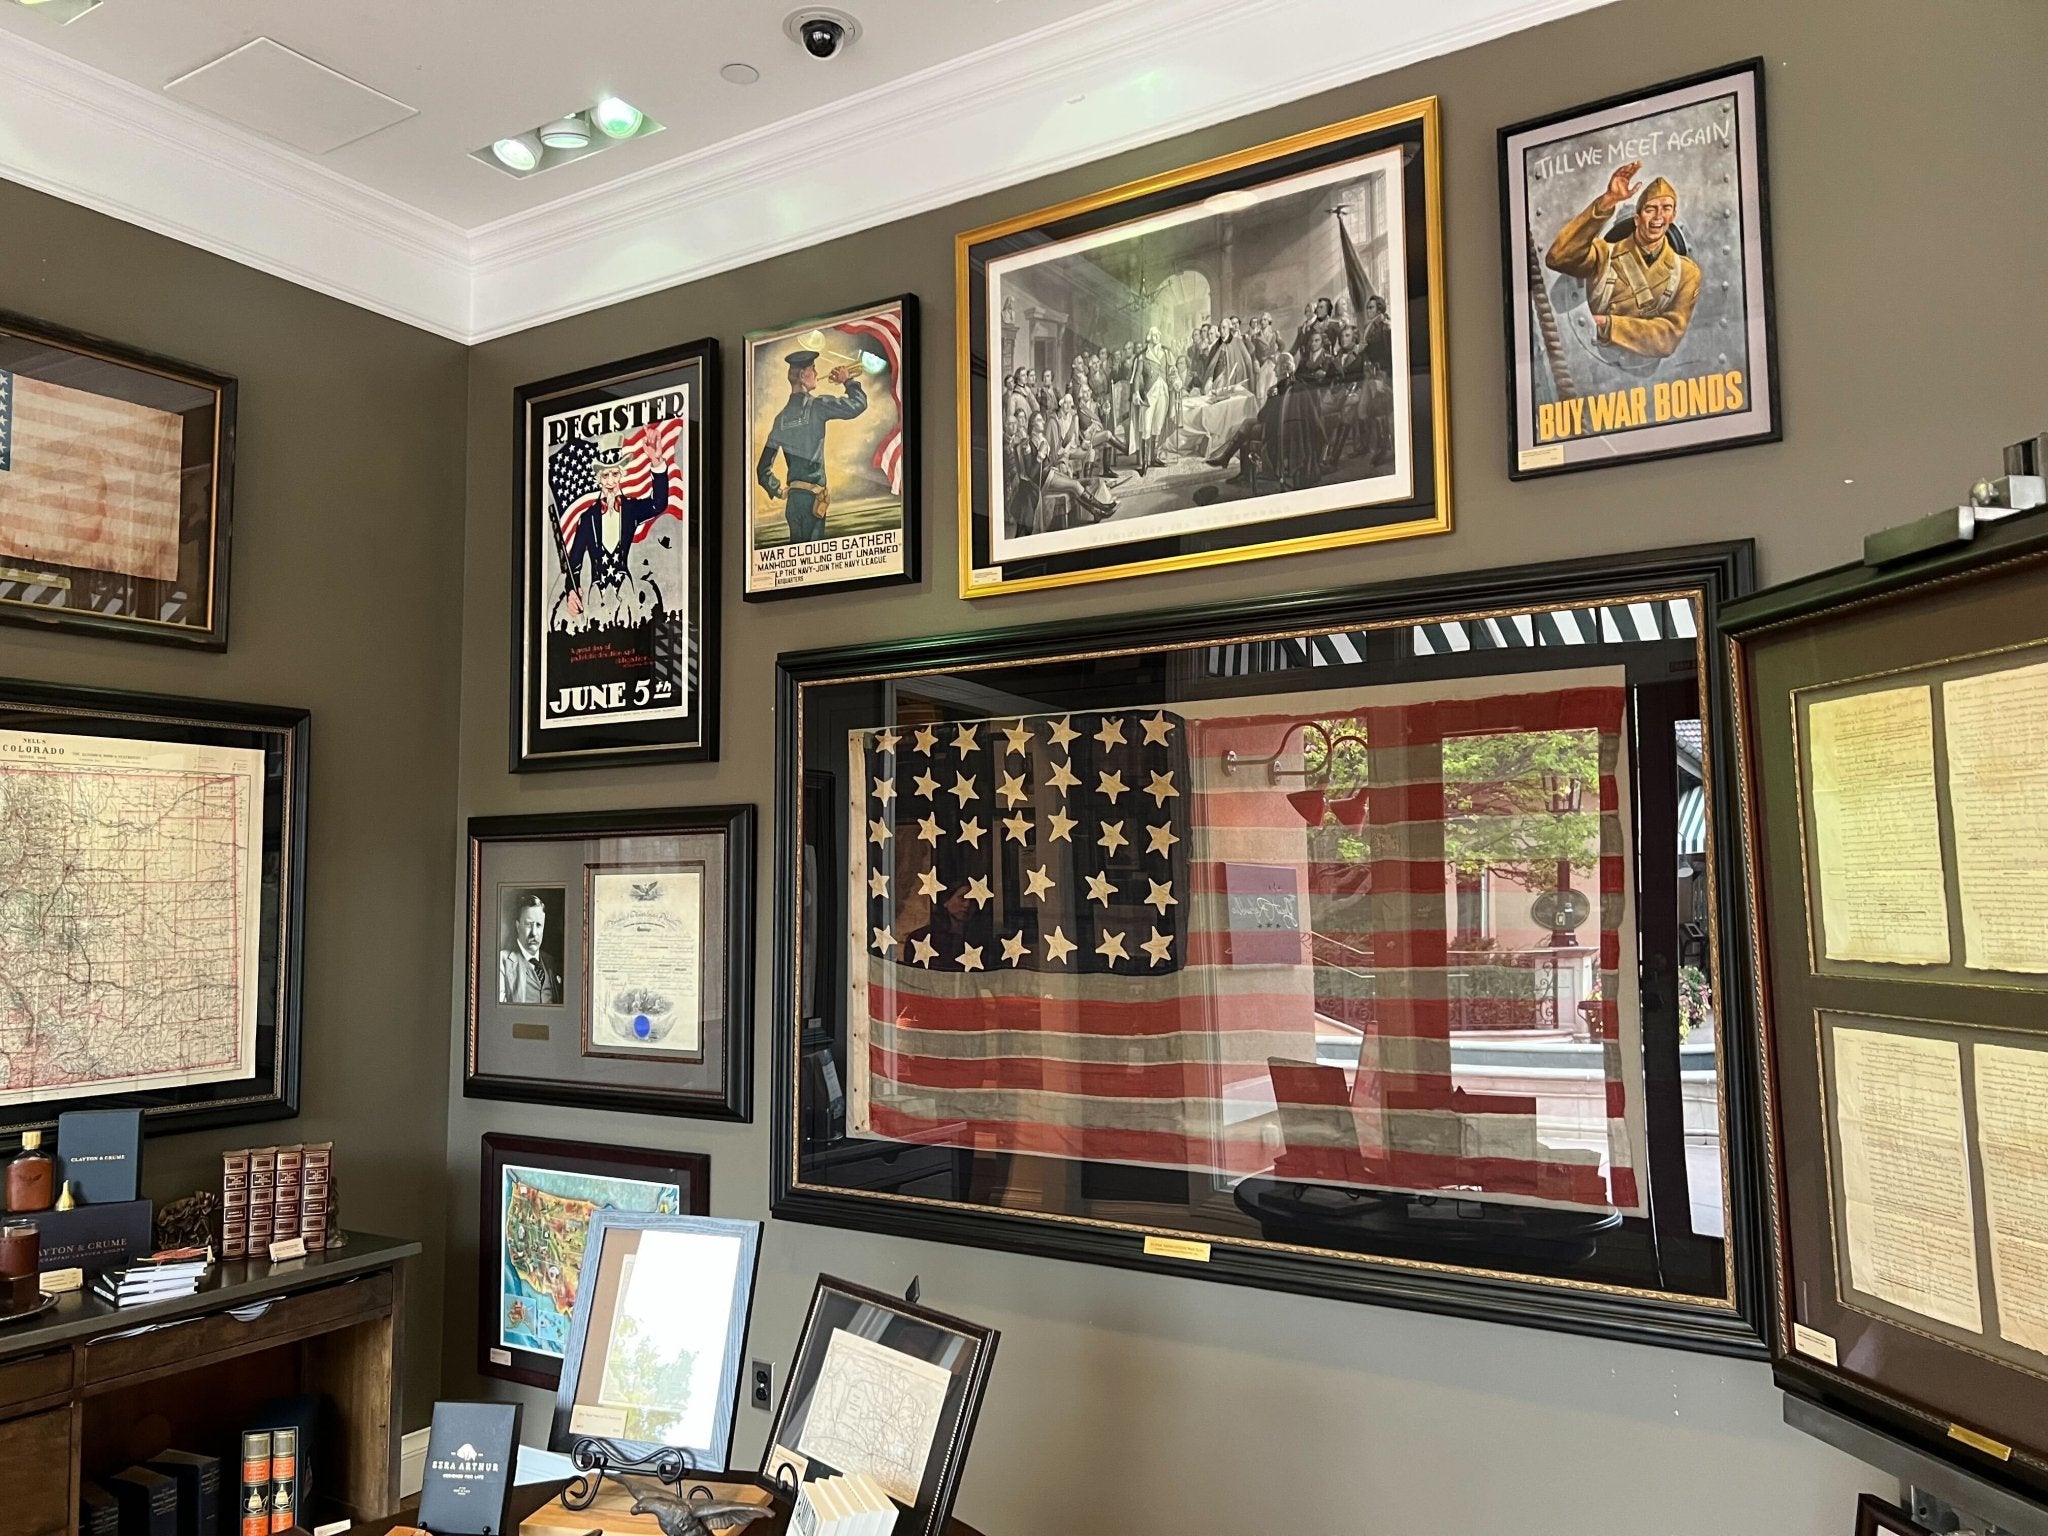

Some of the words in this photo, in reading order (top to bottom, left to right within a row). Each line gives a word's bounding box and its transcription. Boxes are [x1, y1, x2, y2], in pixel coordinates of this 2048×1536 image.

[1534, 154, 1575, 179] TILL
[1575, 146, 1602, 169] WE
[1608, 131, 1664, 163] MEET
[1667, 120, 1730, 151] AGAIN
[1538, 397, 1585, 441] BUY
[1587, 386, 1648, 433] WAR
[1653, 370, 1744, 422] BONDS
[548, 391, 685, 447] REGISTER
[760, 548, 785, 562] WAR
[788, 540, 838, 558] CLOUDS
[842, 531, 897, 550] GATHER!
[800, 553, 832, 566] WILLING
[836, 551, 853, 560] BUT
[785, 566, 796, 576] THE
[831, 560, 843, 571] THE
[844, 558, 860, 569] NAVY
[861, 555, 887, 566] LEAGUE
[549, 681, 627, 714] JUNE
[2, 744, 66, 755] COLORADO
[38, 1245, 75, 1257] YTON
[87, 1238, 128, 1250] CRUME
[431, 1460, 456, 1471] EZRA
[458, 1461, 499, 1473] ARTHUR
